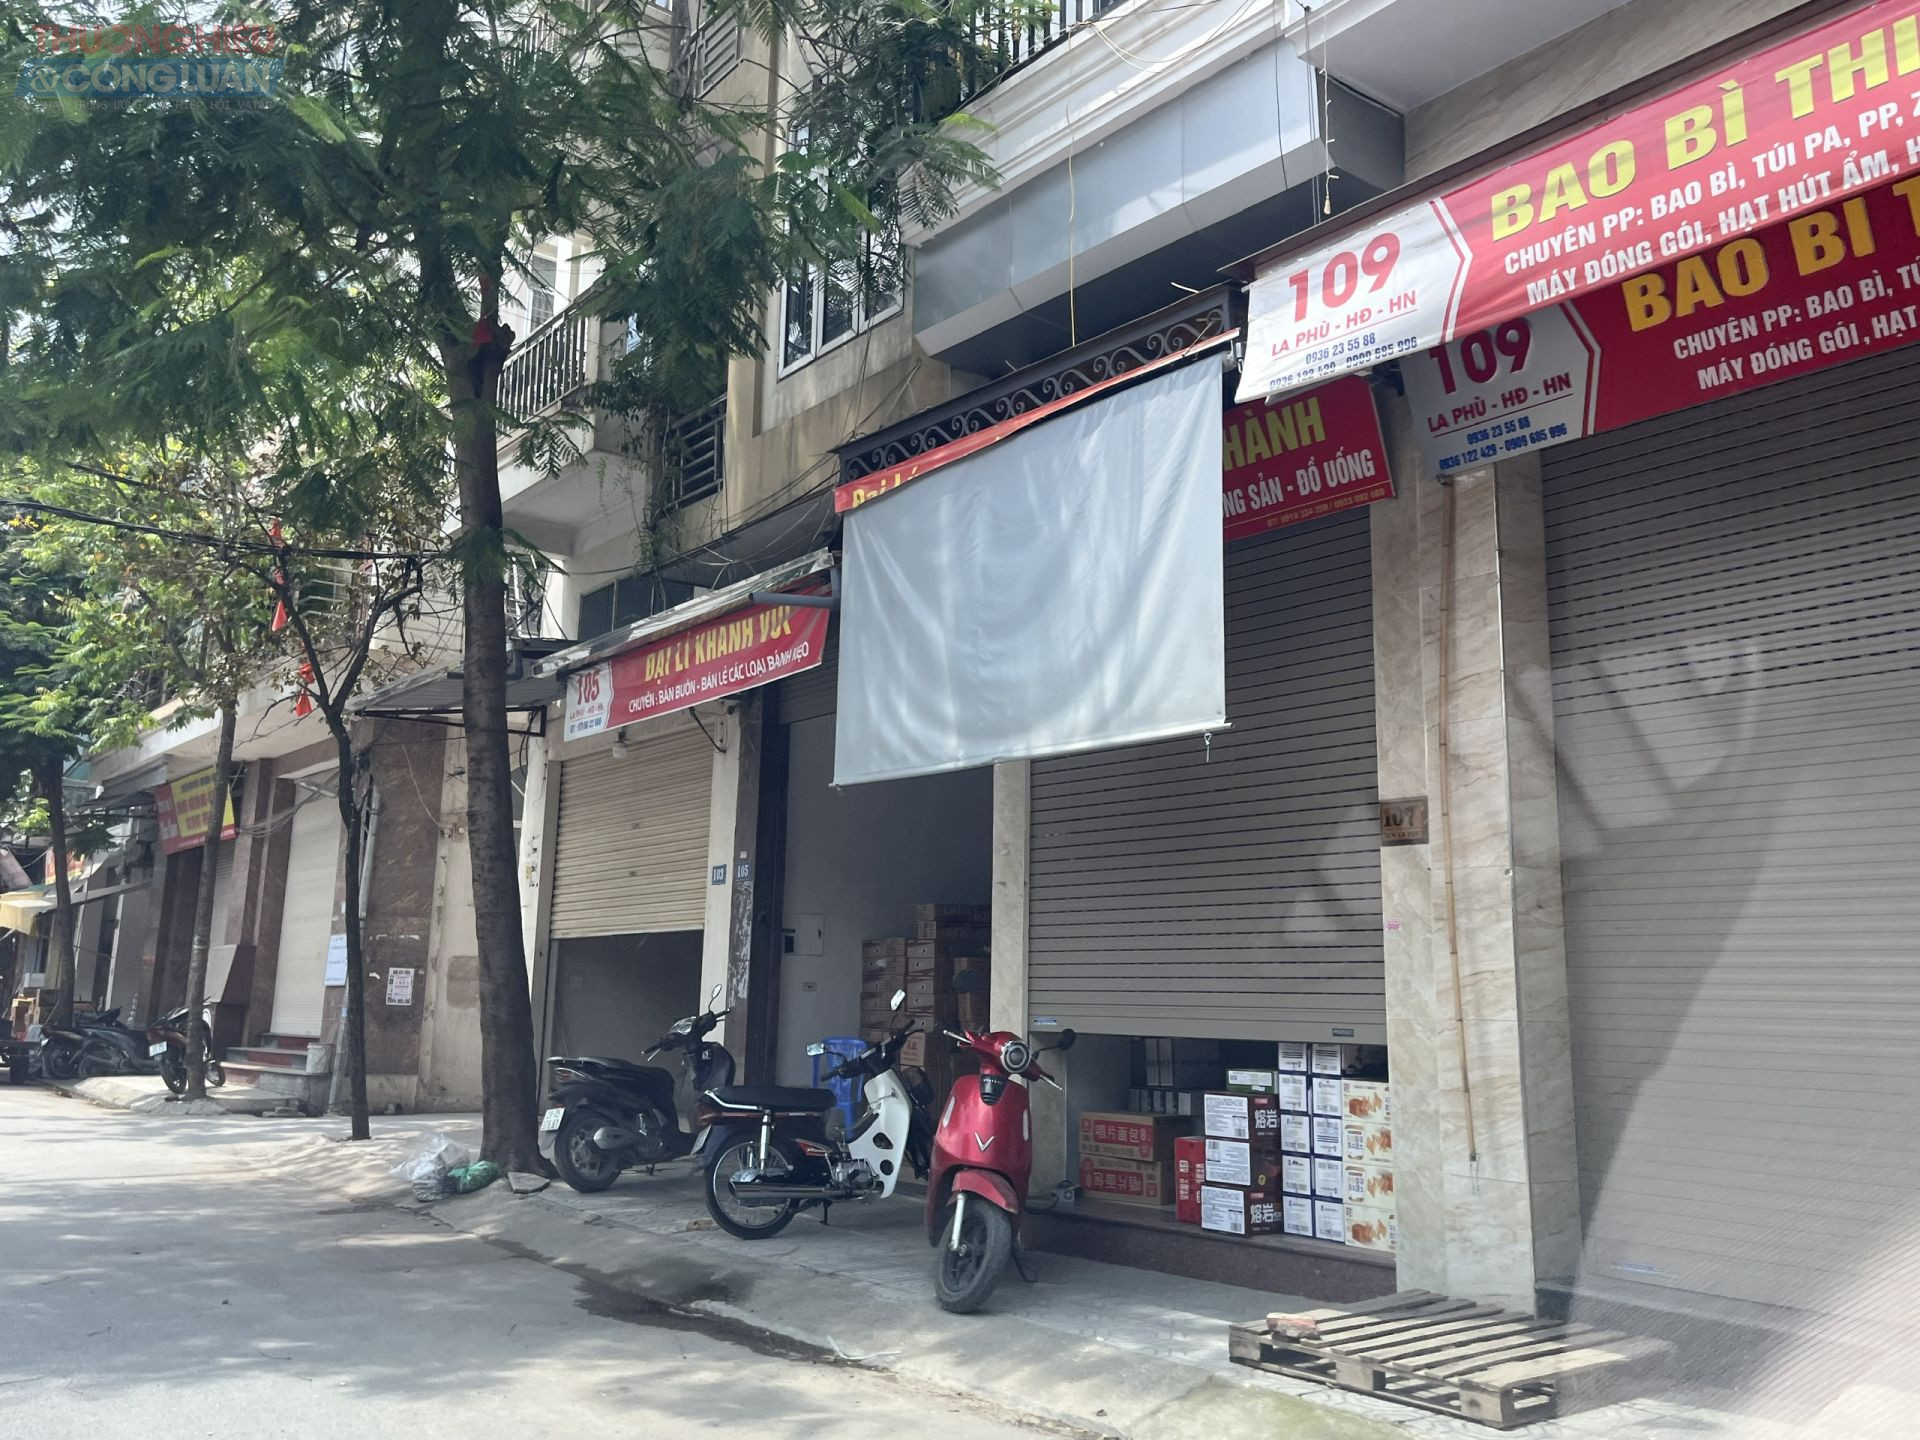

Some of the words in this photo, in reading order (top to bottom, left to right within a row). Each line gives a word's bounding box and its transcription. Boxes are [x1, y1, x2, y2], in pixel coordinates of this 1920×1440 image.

[1491, 139, 1636, 242] BAO
[1664, 79, 1748, 171] BÌ
[1504, 221, 1596, 275] CHUYÊN
[1603, 206, 1644, 238] PP:
[1650, 181, 1702, 220] BAO
[1709, 161, 1746, 197] BÌ,
[1752, 142, 1797, 178] TÚI
[1804, 125, 1850, 160] PA,
[1858, 102, 1904, 138] PP,
[1526, 266, 1576, 306] MÁY
[1584, 240, 1653, 284] ĐÓNG
[1659, 218, 1712, 257] GÓI,
[1718, 194, 1770, 237] HẠT
[1777, 171, 1831, 213] HÚT
[1842, 150, 1900, 190] ẨM,
[1289, 232, 1401, 323] 109
[1621, 237, 1769, 332] BAO
[1271, 338, 1289, 357] LA
[1295, 321, 1330, 348] PHÙ
[1346, 307, 1372, 329] HĐ
[1389, 290, 1416, 314] HN
[1673, 315, 1758, 359] CHUYÊN
[1762, 303, 1802, 332] PP:
[1806, 285, 1854, 318] BAO
[1859, 269, 1893, 303] BÌ,
[1697, 357, 1743, 390] MÁY
[1750, 337, 1813, 375] ĐÓNG
[1871, 305, 1917, 338] HẠT
[1305, 348, 1330, 365] 0936
[1332, 342, 1345, 356] 23
[1347, 337, 1360, 353] 55
[1363, 332, 1376, 347] 88
[1429, 317, 1531, 395] 109
[1428, 413, 1449, 433] LA
[1452, 396, 1487, 425] PHÙ
[1501, 387, 1528, 409] HĐ
[1543, 372, 1572, 396] HN
[1467, 429, 1490, 445] 0936
[1491, 424, 1503, 438] 23
[1504, 420, 1517, 433] 55
[1248, 472, 1284, 510] SẢN
[1323, 446, 1376, 488] UỐNG
[1462, 448, 1479, 464] 122
[644, 646, 671, 685] ĐẠI
[695, 617, 754, 666] KHANH
[658, 684, 674, 704] BÁN
[675, 681, 696, 701] BUÔN
[701, 671, 718, 691] BÁN
[728, 662, 745, 682] CÁC
[745, 659, 767, 678] LOẠI
[737, 864, 749, 879] 105
